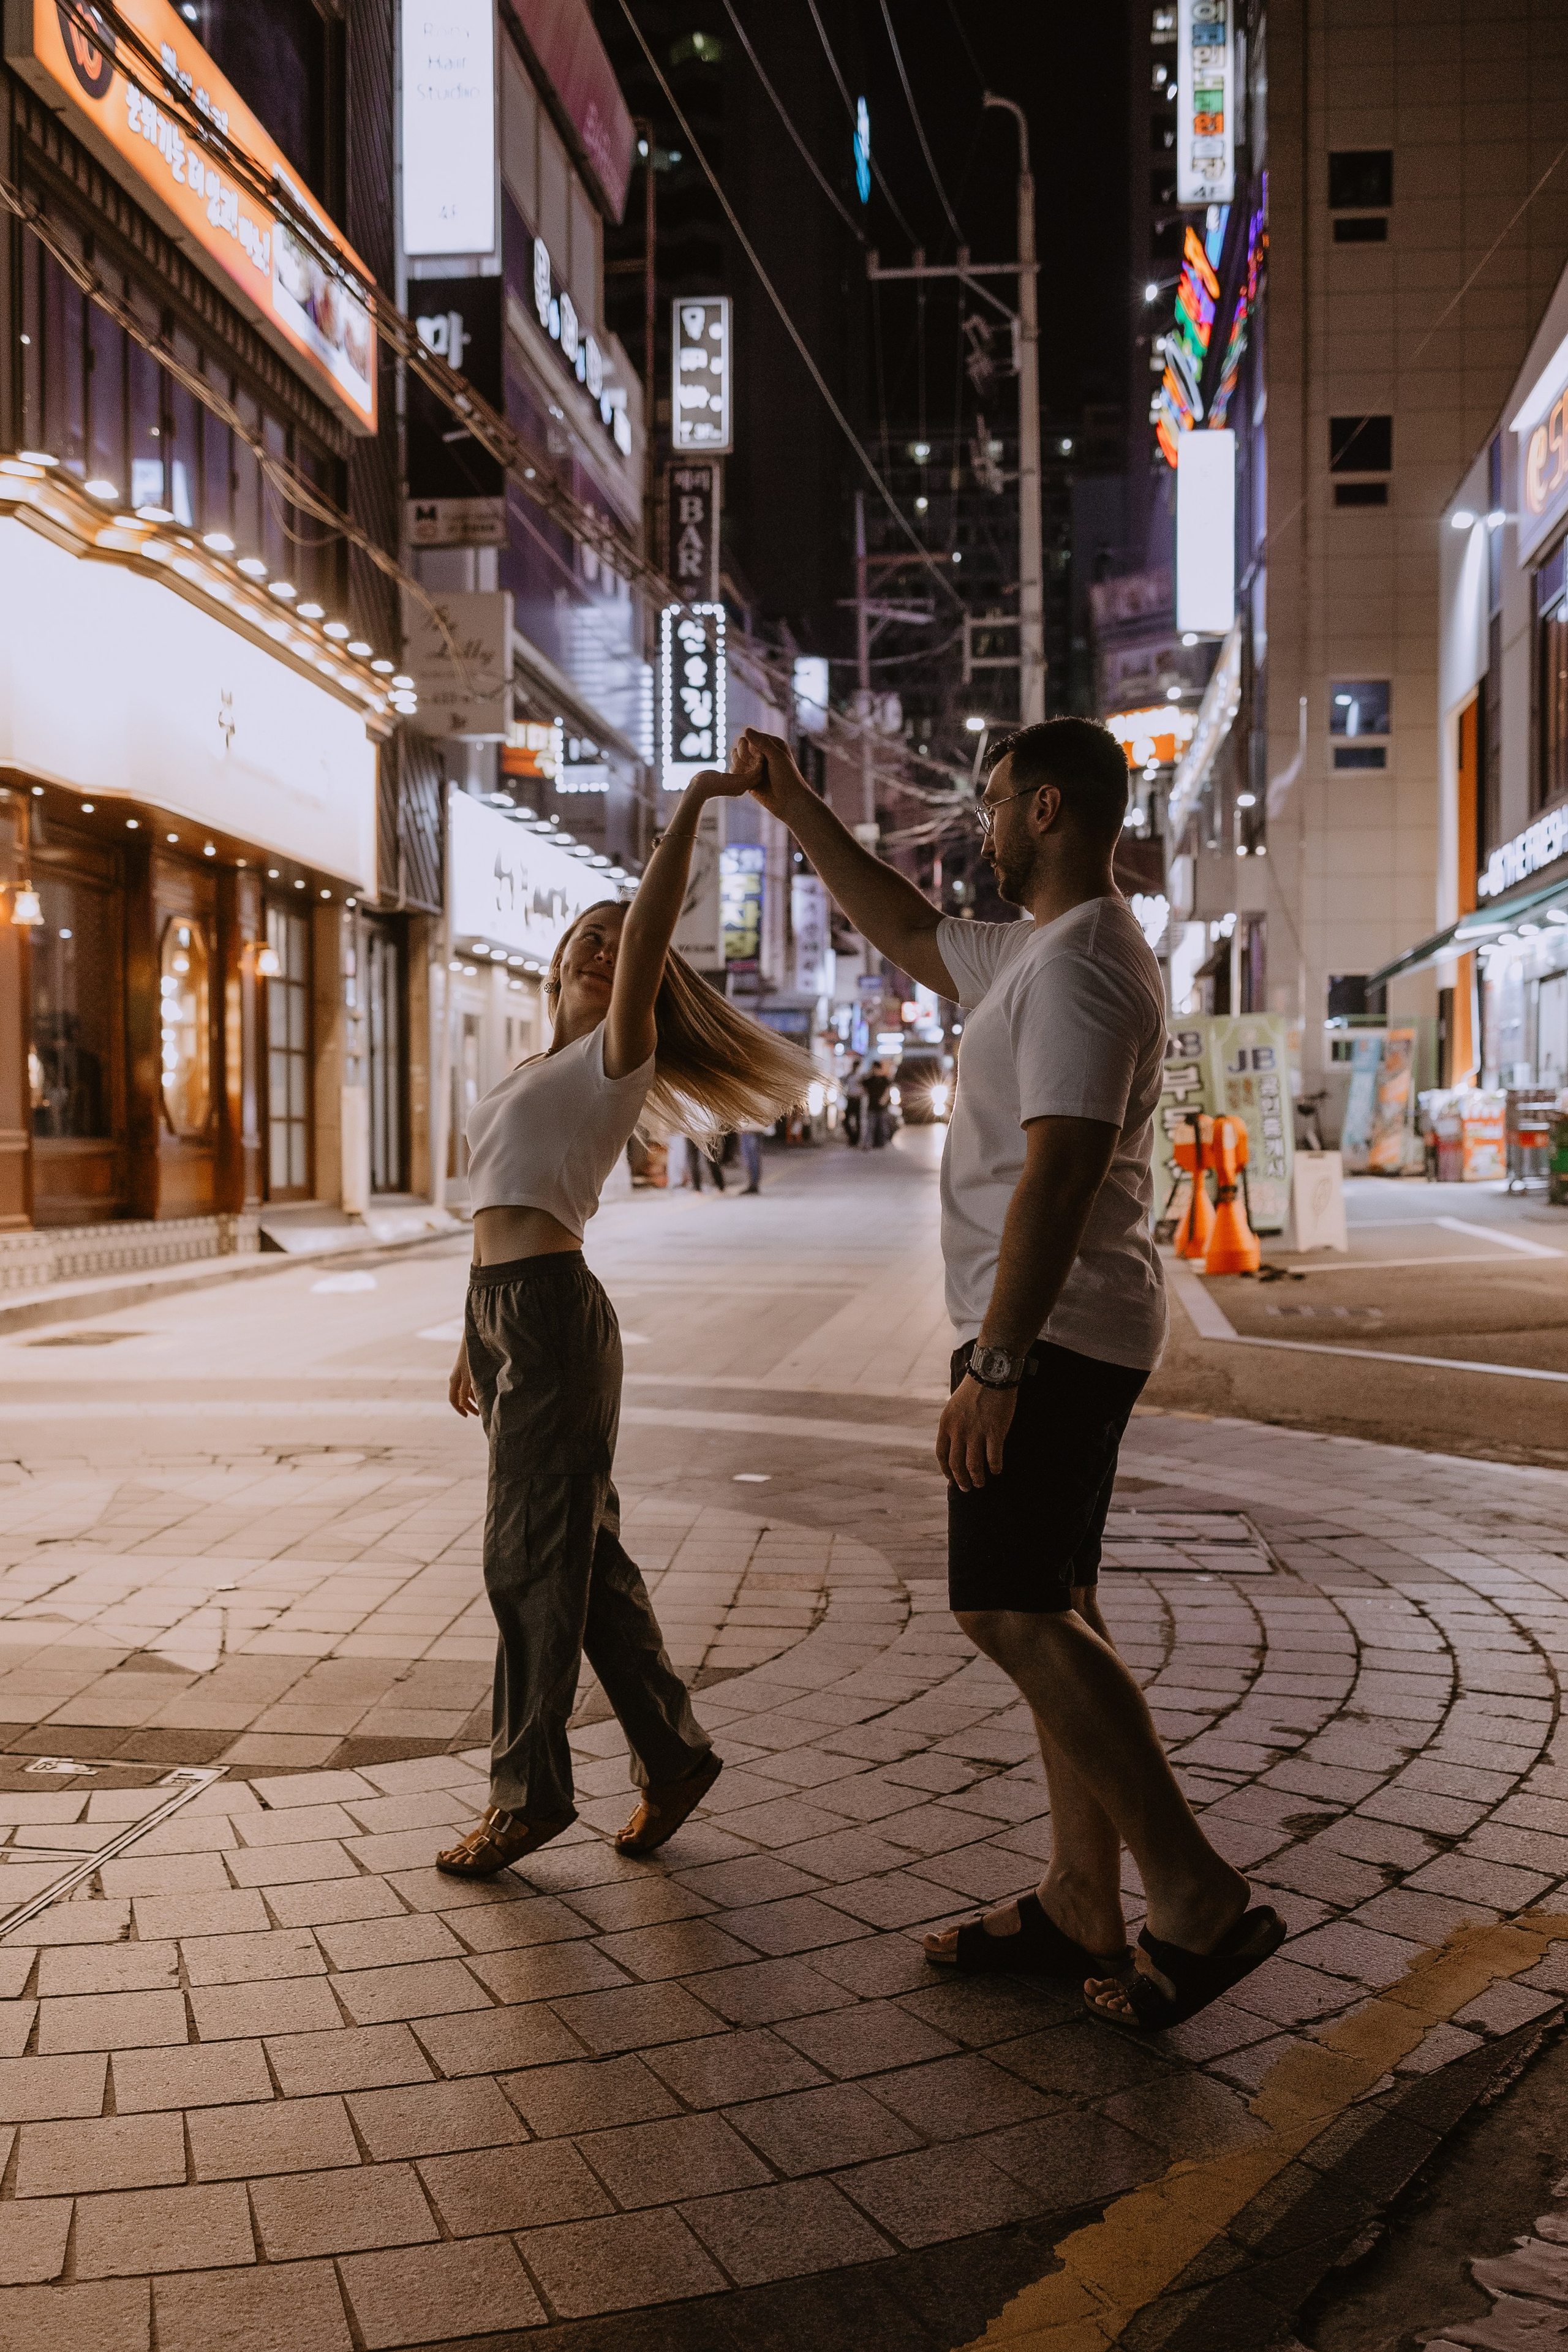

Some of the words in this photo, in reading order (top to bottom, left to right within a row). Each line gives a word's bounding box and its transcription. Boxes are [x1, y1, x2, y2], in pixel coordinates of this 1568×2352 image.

[428, 54, 467, 70] Hair
[417, 82, 481, 100] Studio
[677, 495, 705, 578] BAR
[1228, 1047, 1276, 1073] JB
